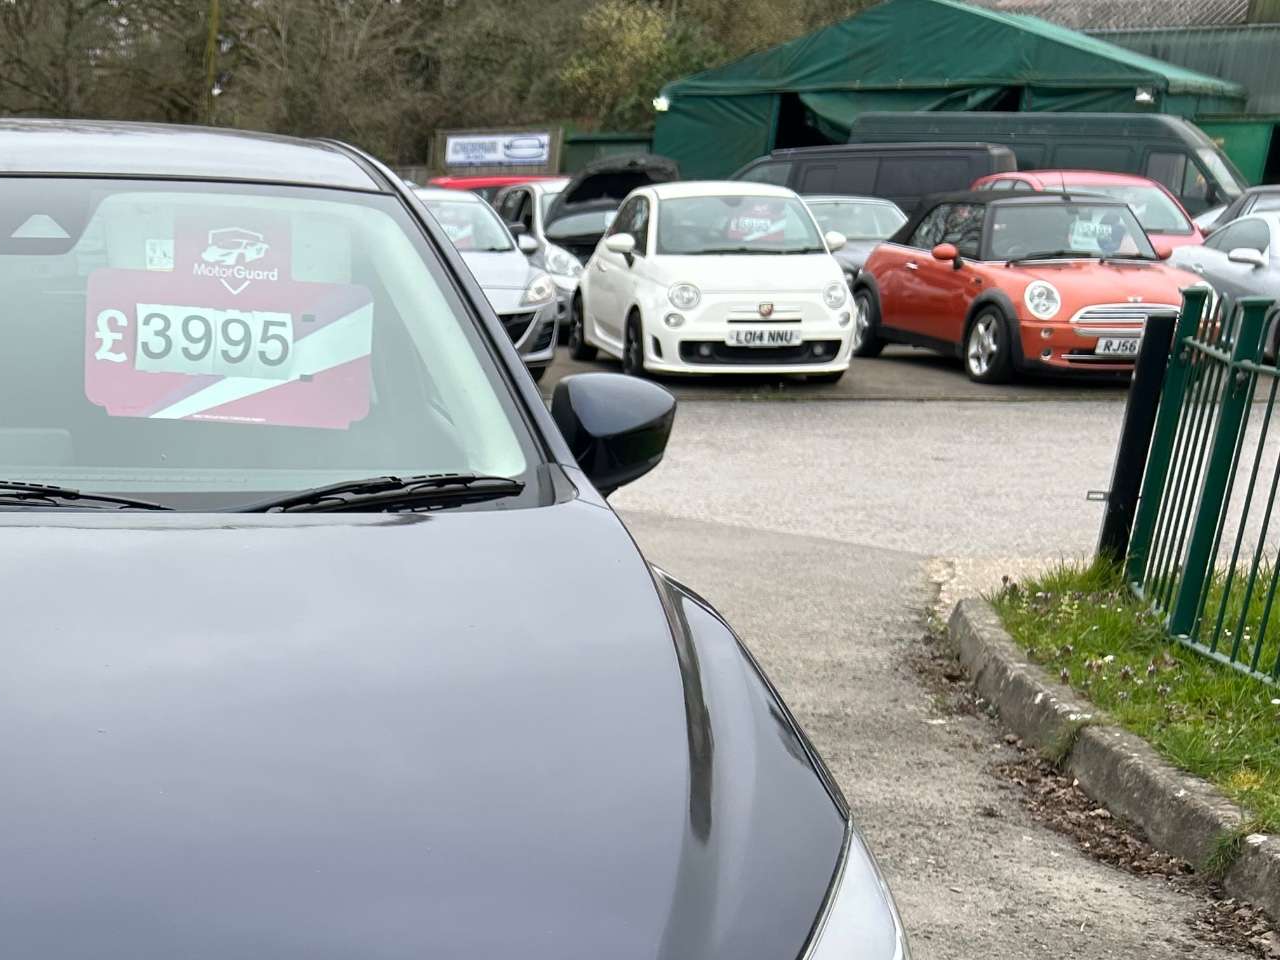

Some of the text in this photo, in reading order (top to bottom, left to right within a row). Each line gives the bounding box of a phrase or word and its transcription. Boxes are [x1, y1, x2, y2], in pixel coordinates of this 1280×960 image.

[192, 263, 278, 282] MotorGuard
[767, 330, 793, 344] NNU
[1103, 339, 1137, 352] RJ56
